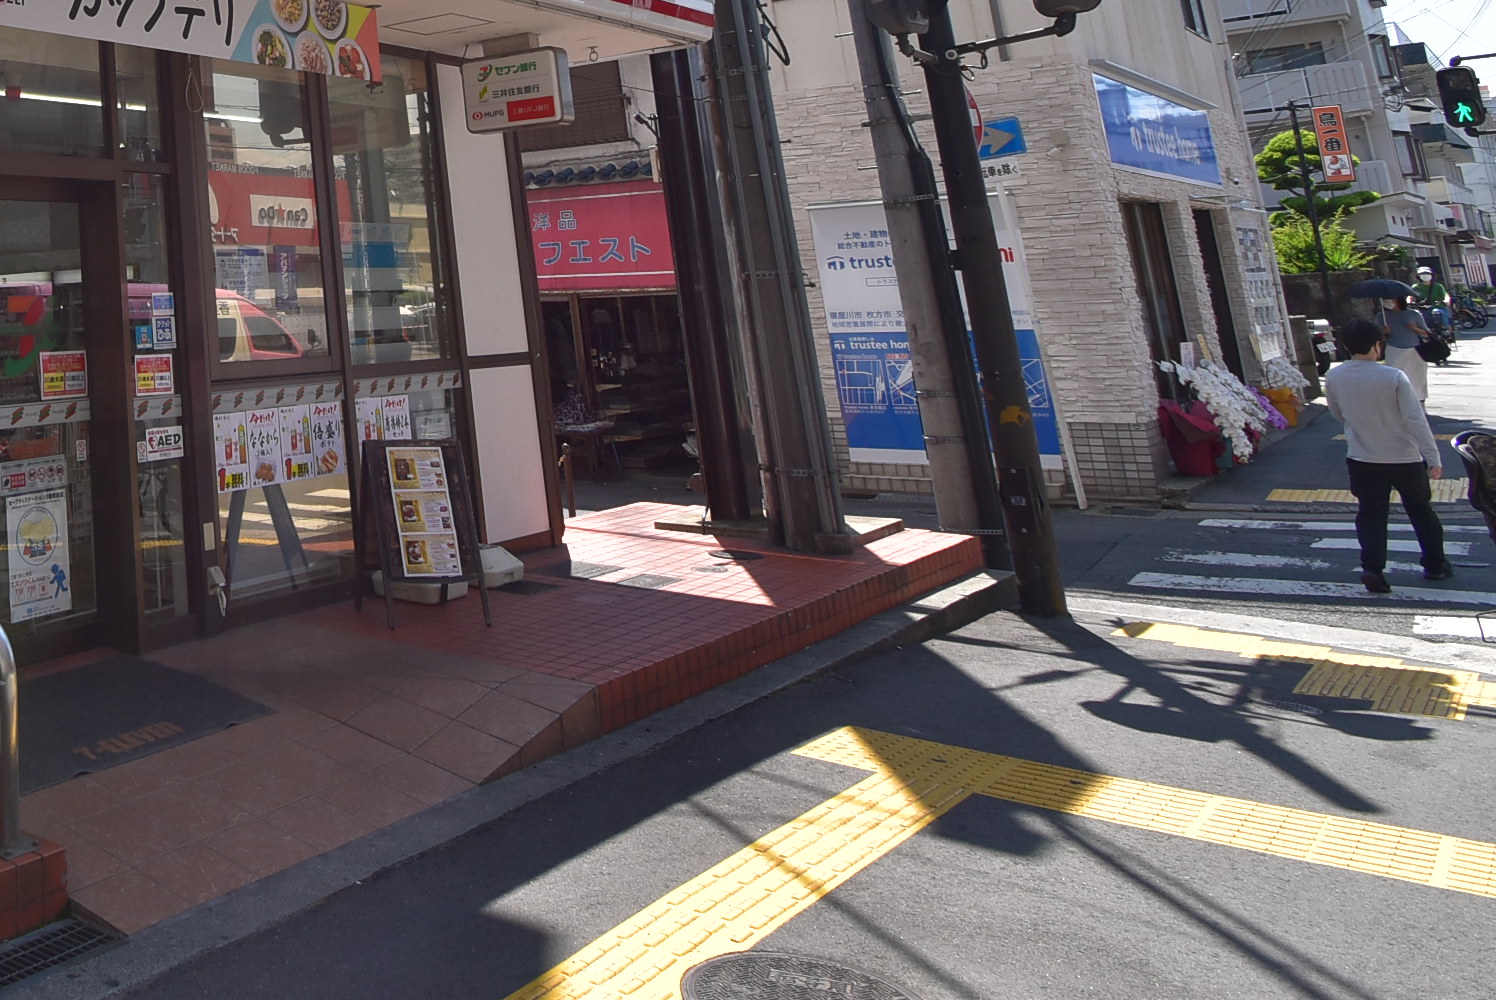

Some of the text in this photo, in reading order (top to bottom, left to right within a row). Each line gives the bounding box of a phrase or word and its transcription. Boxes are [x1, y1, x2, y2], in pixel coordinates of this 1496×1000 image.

[494, 61, 537, 76] セブン銀行
[491, 84, 540, 99] 三井住友銀行
[484, 110, 504, 118] MUFG
[532, 209, 578, 232] 洋品
[843, 229, 888, 240] 土地・建物
[829, 311, 862, 320] 寝屋川市
[866, 310, 891, 318] 枚方市
[849, 340, 888, 350] trustee
[156, 433, 181, 447] AED
